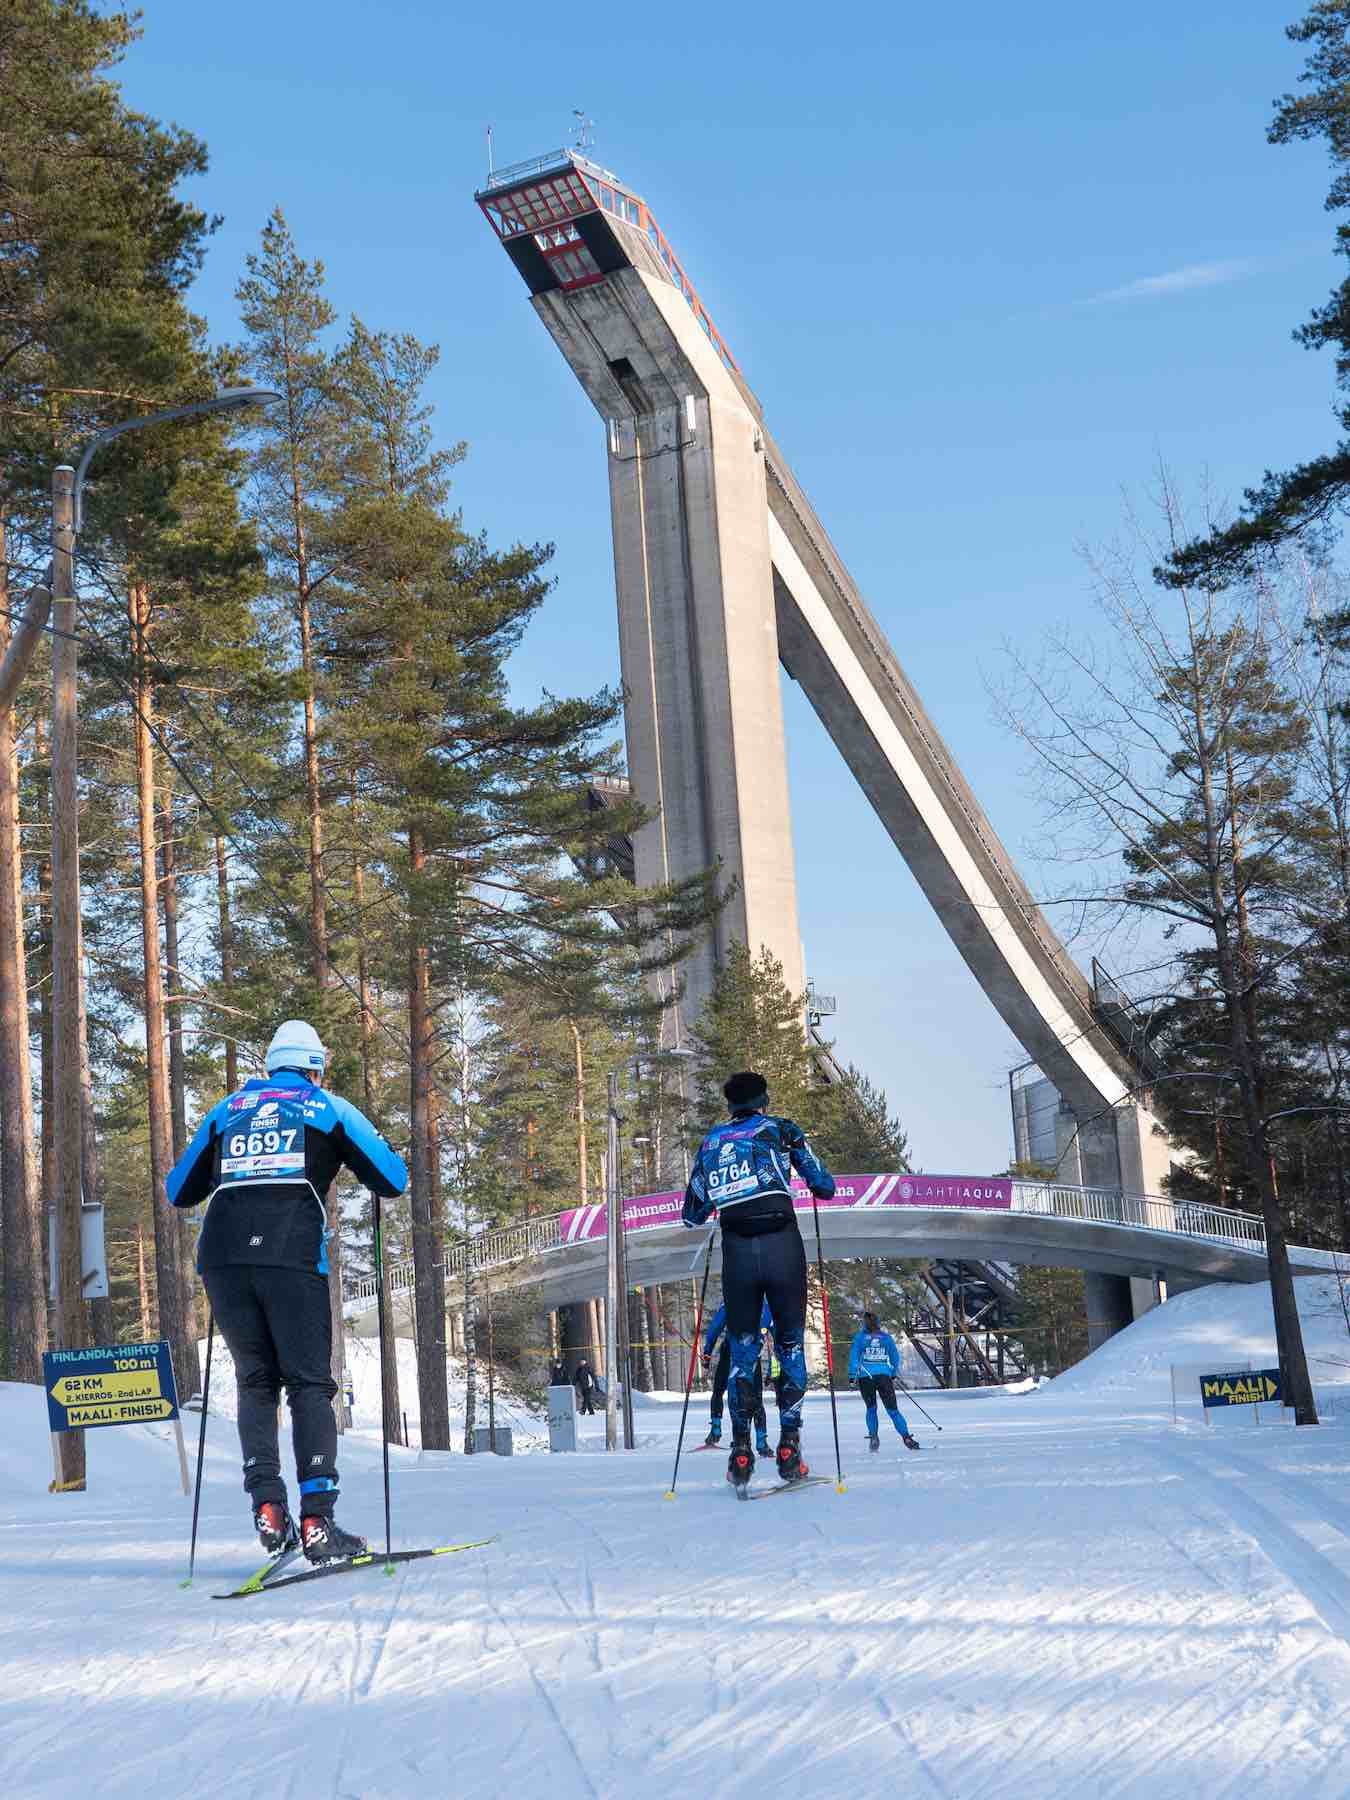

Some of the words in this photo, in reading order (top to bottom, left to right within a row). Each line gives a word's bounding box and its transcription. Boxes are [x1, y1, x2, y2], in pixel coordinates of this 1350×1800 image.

[230, 1129, 297, 1157] 6697
[709, 1160, 750, 1187] 6764
[915, 1184, 1004, 1200] LAHTIAQUA
[52, 1345, 160, 1363] FINLANDIA-HIIHTO
[114, 1359, 138, 1371] 100
[64, 1380, 81, 1391] 62
[83, 1378, 103, 1389] KM
[1203, 1376, 1264, 1398] MAALI
[75, 1391, 113, 1401] KIERROS
[118, 1389, 133, 1398] 2nd
[1228, 1392, 1265, 1404] FINISH
[70, 1409, 112, 1422] MAALI
[120, 1405, 163, 1417] FINISH
